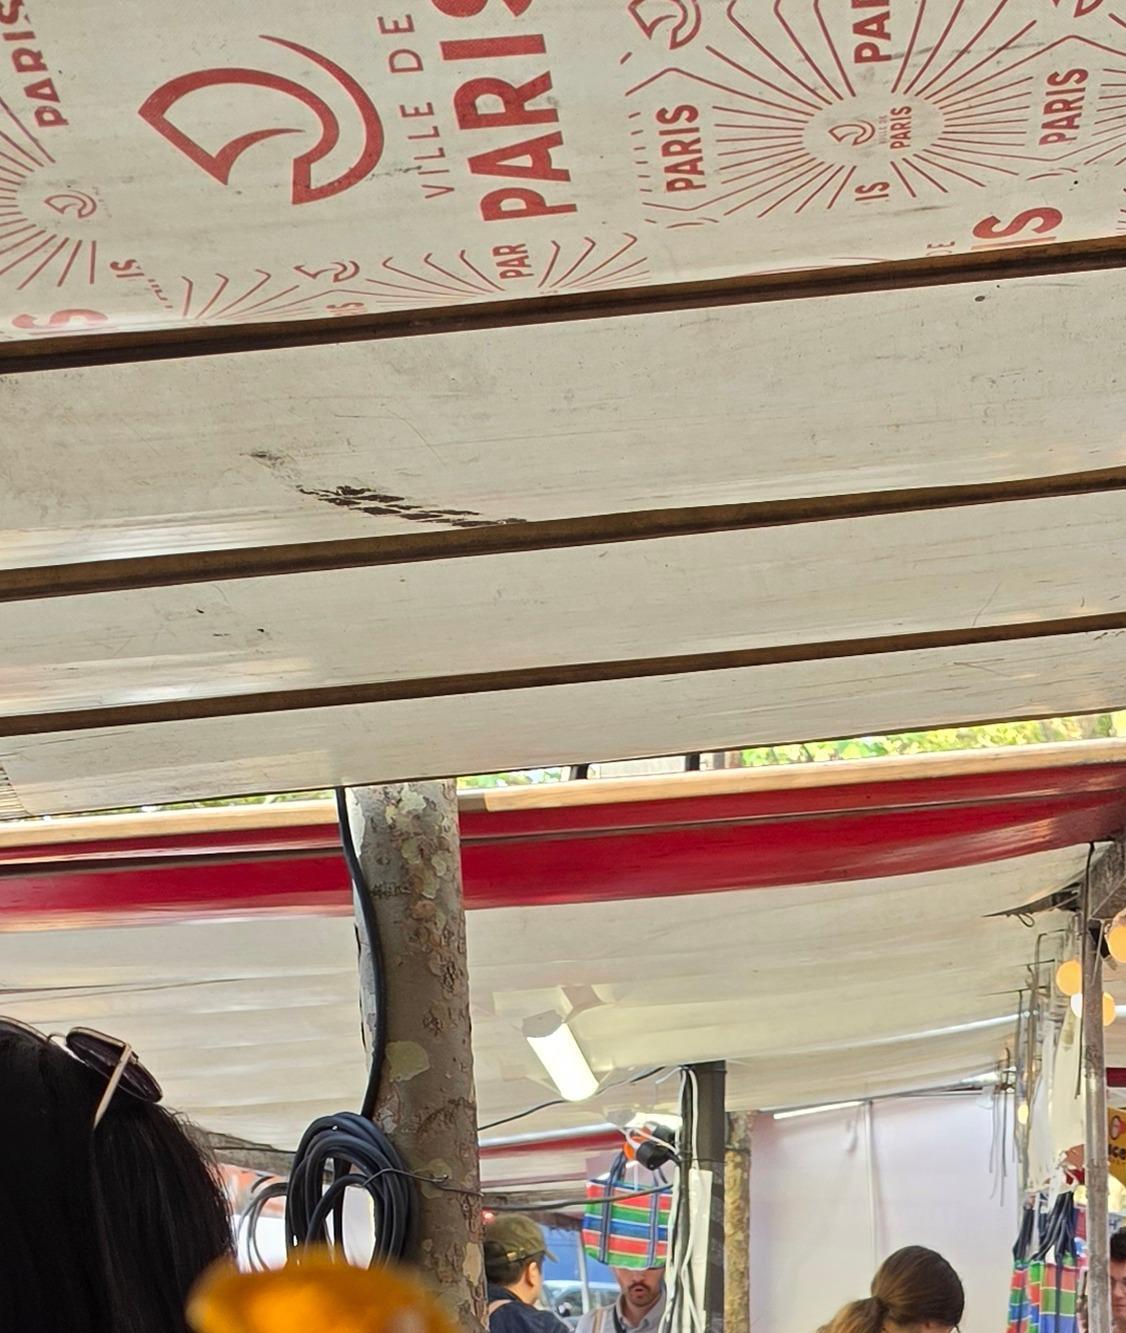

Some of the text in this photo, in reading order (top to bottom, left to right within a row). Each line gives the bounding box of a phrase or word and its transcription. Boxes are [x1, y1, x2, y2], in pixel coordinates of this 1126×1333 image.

[377, 14, 455, 199] VILLE DE
[890, 106, 912, 149] PARIS
[1039, 68, 1089, 146] PARIS
[655, 104, 707, 192] PARIS
[492, 243, 534, 280] PAR
